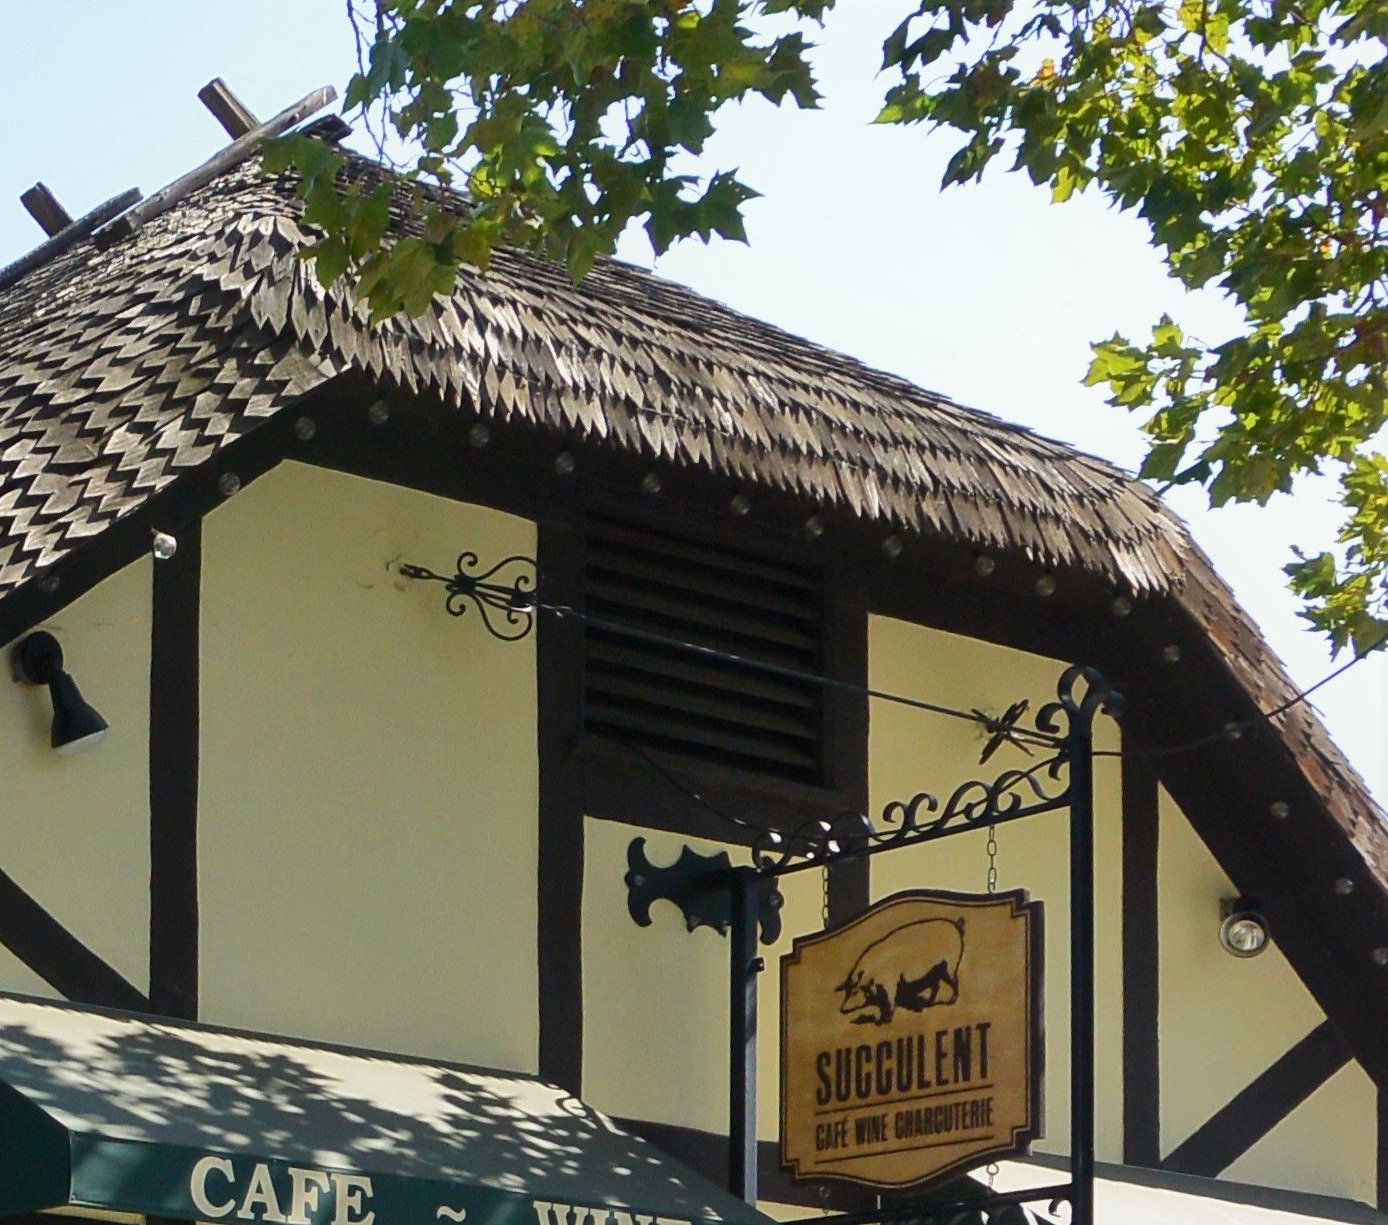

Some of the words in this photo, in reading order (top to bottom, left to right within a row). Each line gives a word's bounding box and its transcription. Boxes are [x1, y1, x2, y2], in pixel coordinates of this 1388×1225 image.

[816, 1022, 992, 1106] SUCCULENT
[816, 1115, 849, 1151] CAFÉ
[855, 1113, 888, 1146] WINE
[895, 1097, 994, 1140] CHARCUTERIE
